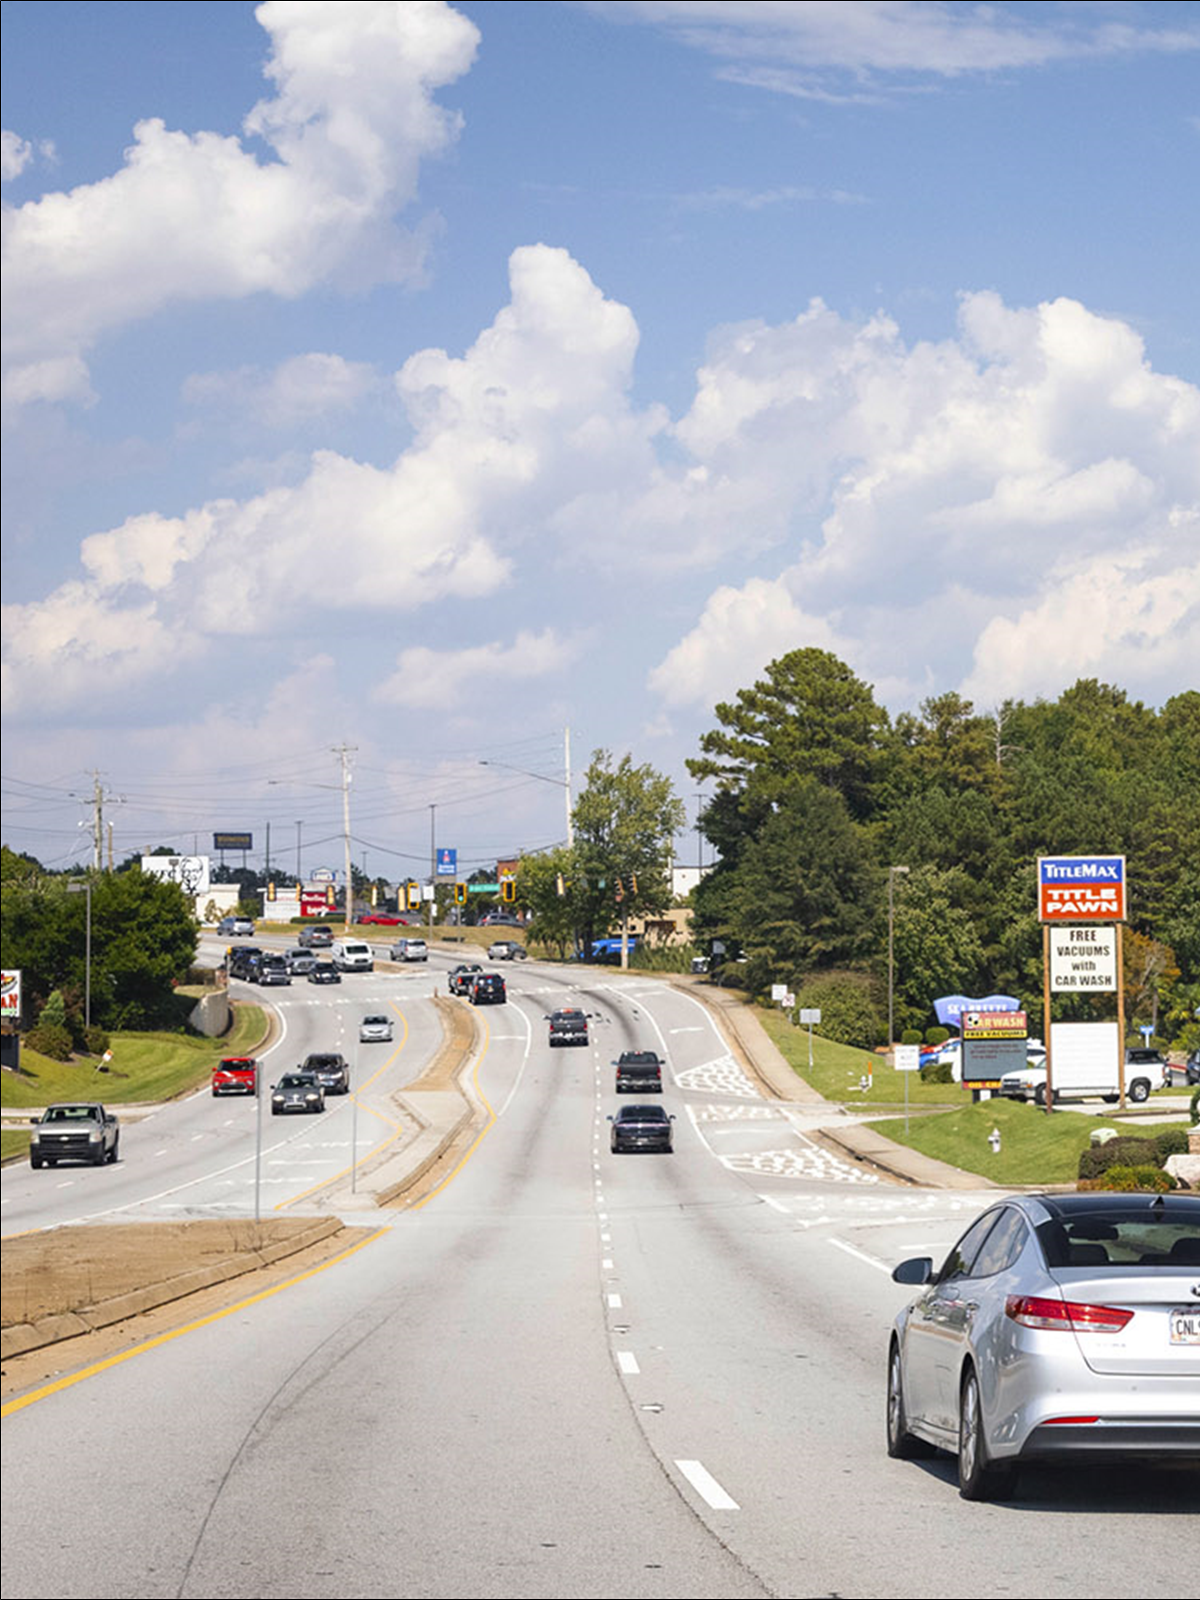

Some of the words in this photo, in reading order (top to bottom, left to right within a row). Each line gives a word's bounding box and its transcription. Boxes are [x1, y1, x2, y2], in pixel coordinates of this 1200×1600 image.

[1047, 888, 1117, 900] TITLE
[1046, 901, 1118, 913] PAWN
[1069, 930, 1097, 942] FREE
[1056, 945, 1111, 957] VACUUMS
[1071, 960, 1097, 971] with
[1054, 975, 1077, 986] CAR
[1079, 975, 1112, 986] WASH
